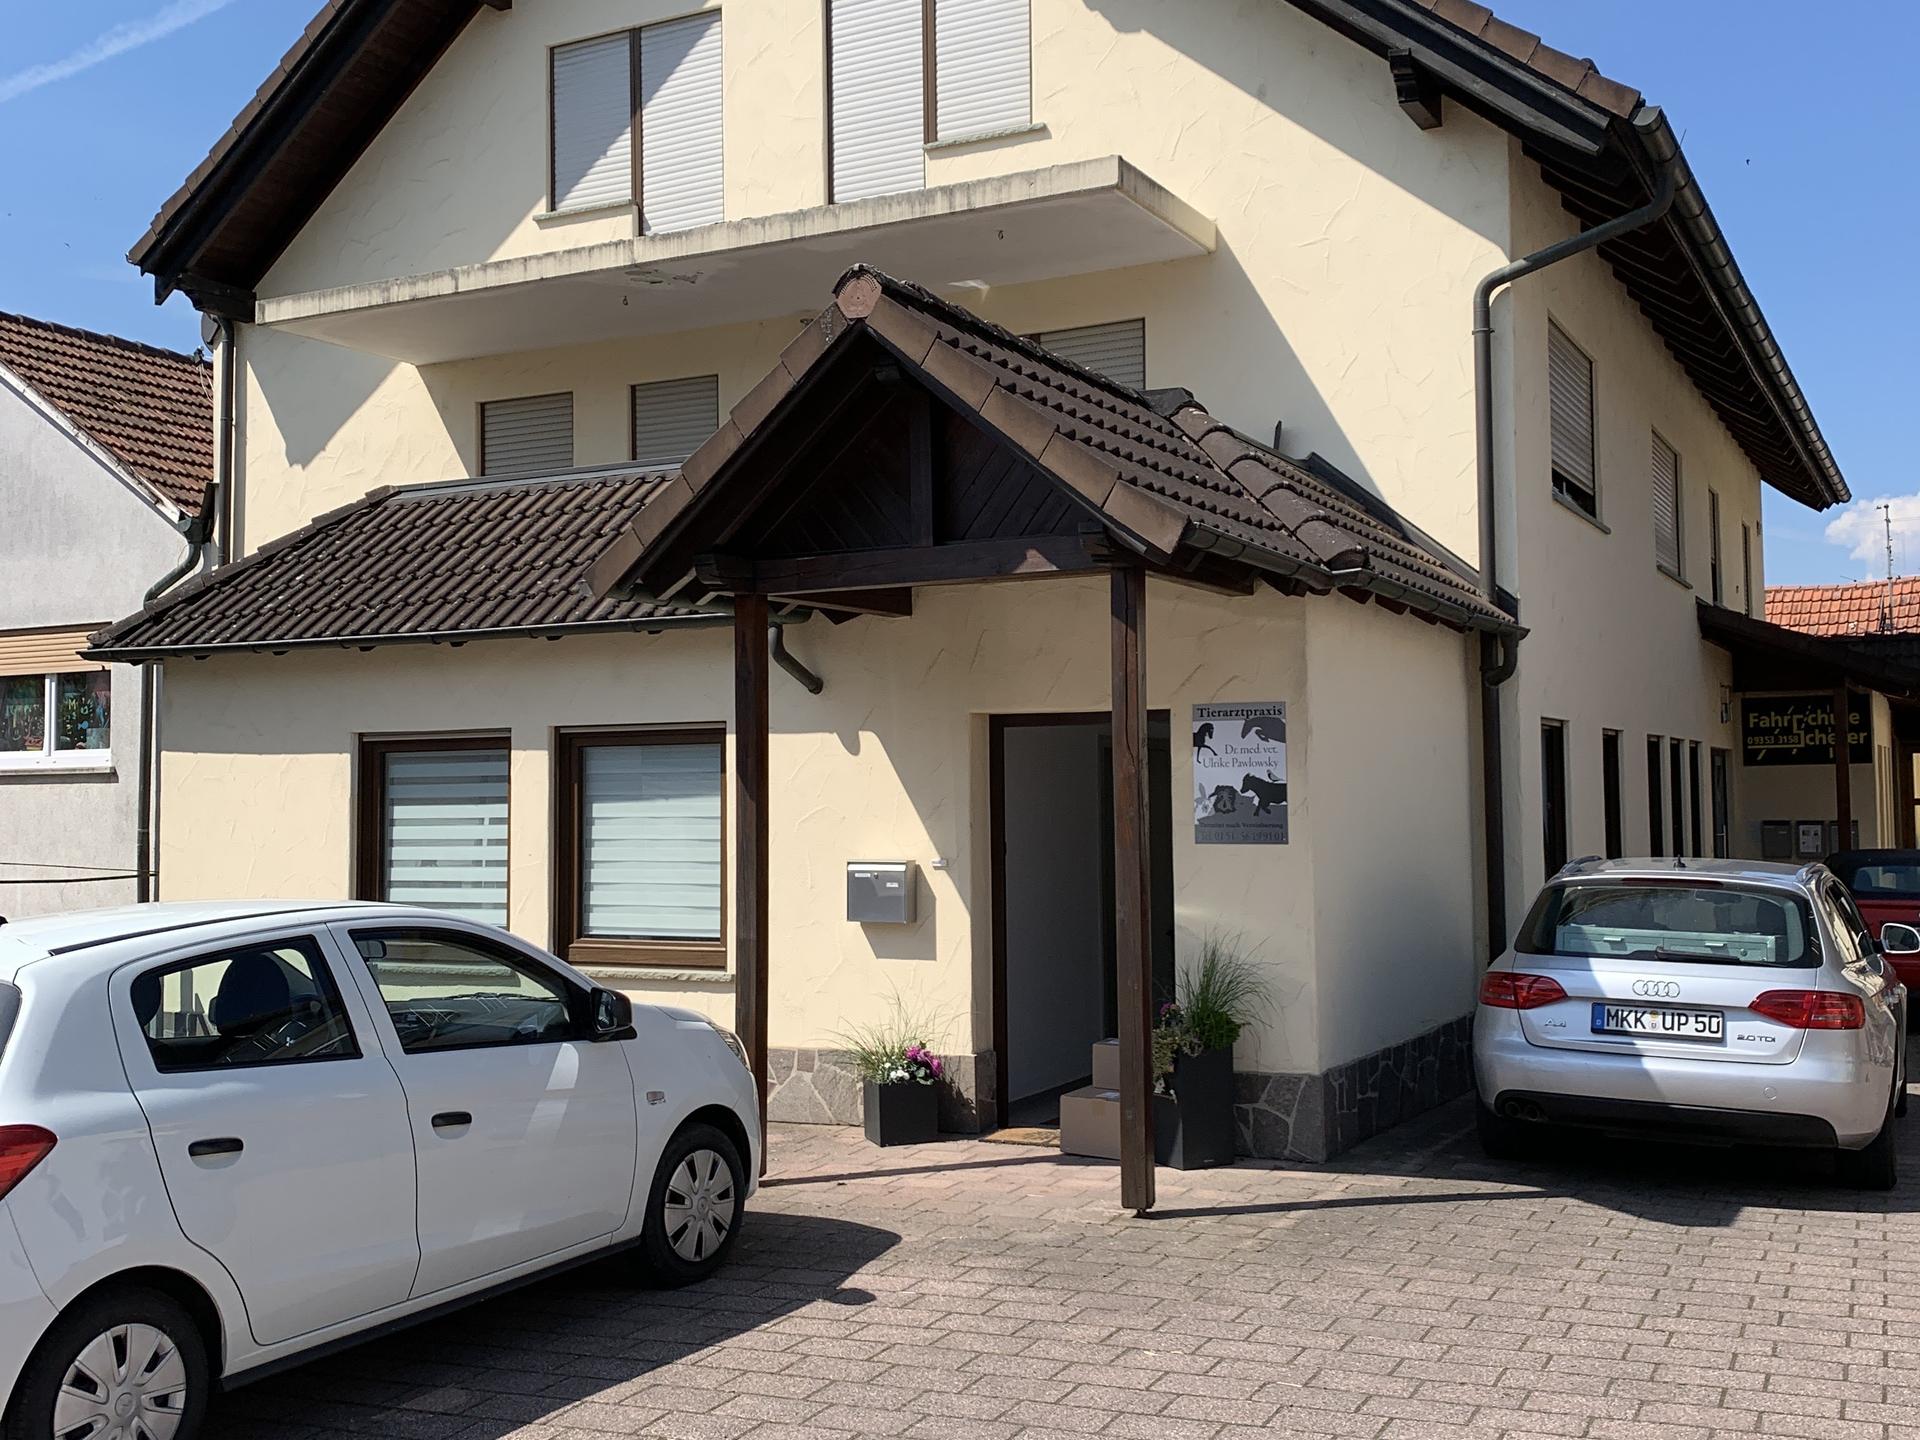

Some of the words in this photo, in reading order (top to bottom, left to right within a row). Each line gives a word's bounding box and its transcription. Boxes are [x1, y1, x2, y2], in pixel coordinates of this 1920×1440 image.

[1197, 706, 1282, 719] Tierarztpraxis
[1225, 744, 1239, 754] Dr.
[1241, 743, 1261, 753] med.
[1203, 758, 1230, 768] Ulrike
[1232, 756, 1278, 769] Pawlowsky
[1606, 1008, 1648, 1029] MKK
[1662, 1011, 1689, 1031] UP
[1694, 1014, 1721, 1034] 50
